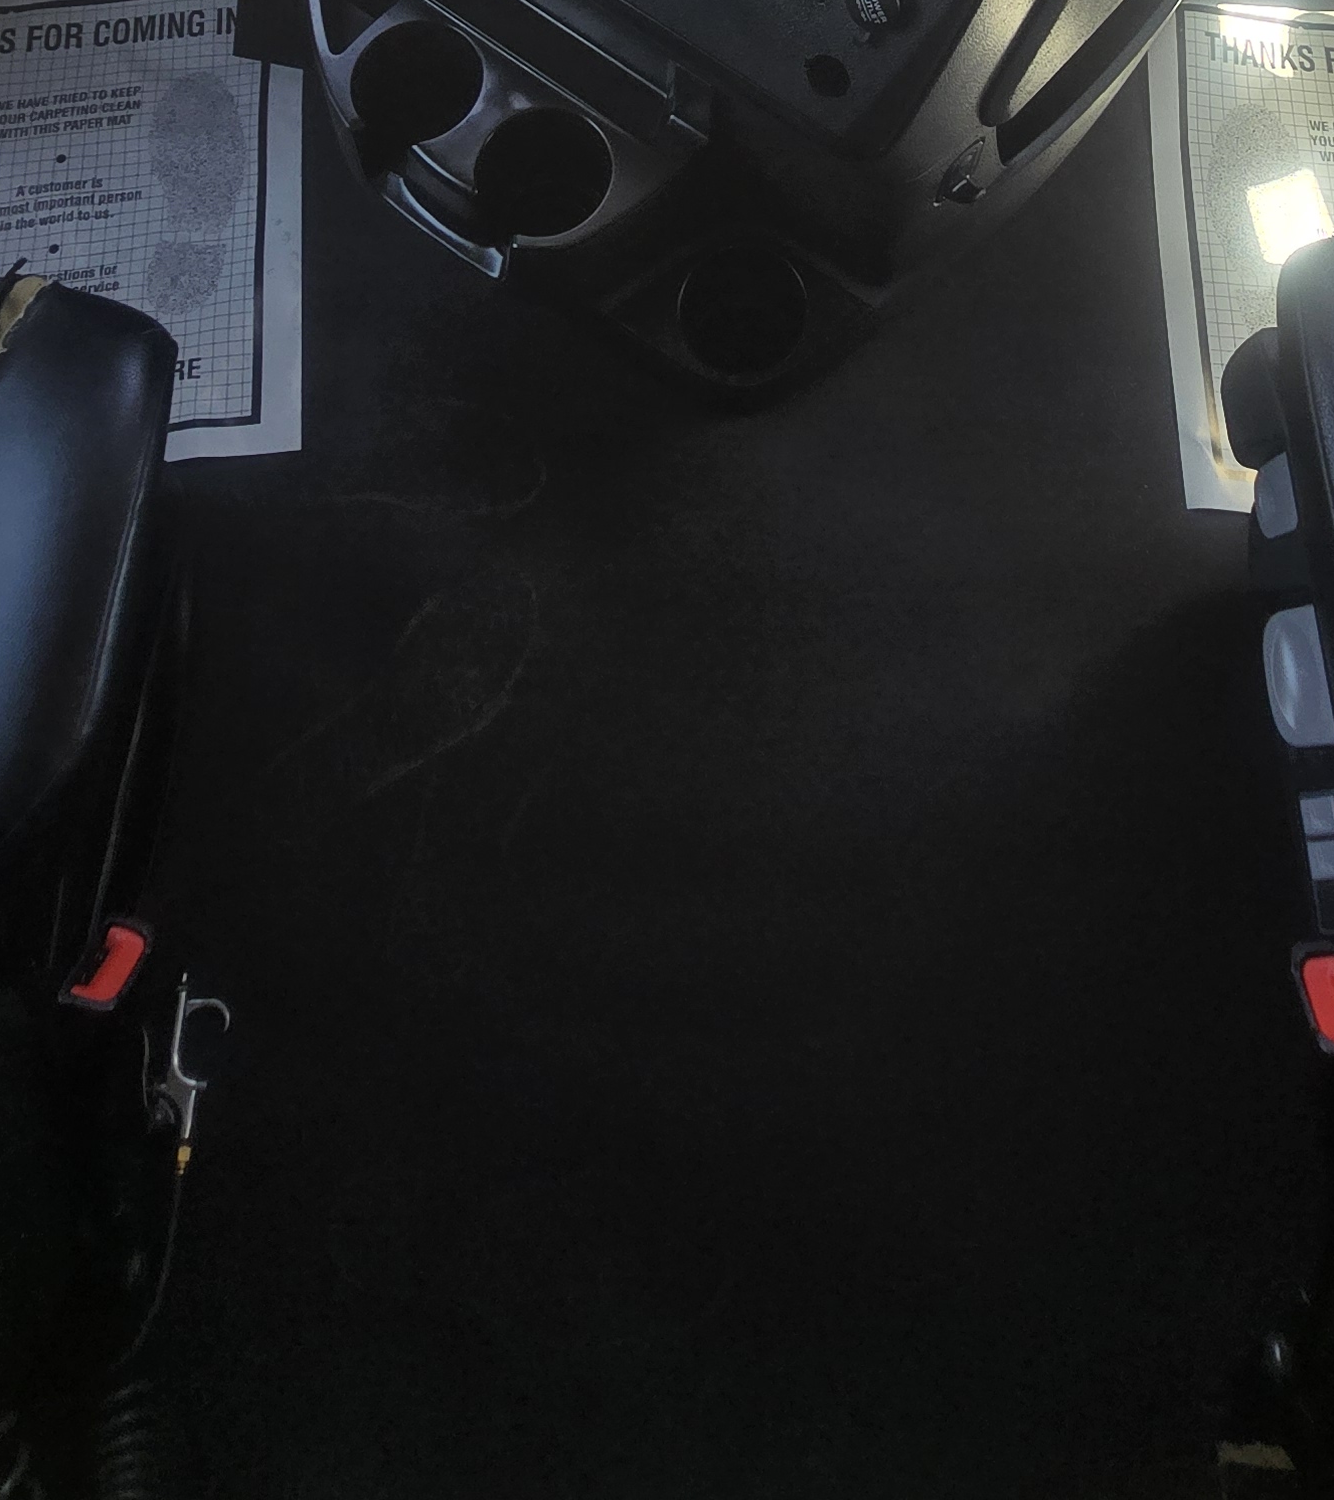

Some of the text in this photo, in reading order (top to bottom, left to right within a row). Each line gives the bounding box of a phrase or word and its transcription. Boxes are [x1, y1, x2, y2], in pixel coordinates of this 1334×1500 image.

[26, 23, 83, 52] FOR
[93, 8, 205, 47] COMING
[216, 7, 237, 35] IN
[1205, 31, 1315, 72] THANKS
[17, 96, 49, 109] HAVE
[53, 90, 87, 104] TRIED
[92, 89, 108, 100] TO
[110, 85, 142, 98] KEEP
[29, 104, 98, 122] CARPETING
[100, 99, 142, 113] CLEAN
[33, 122, 60, 136] THIS
[63, 117, 103, 132] PAPER
[107, 114, 134, 126] MAT
[1309, 120, 1329, 132] WE
[15, 175, 103, 197] A customer is
[0, 202, 30, 216] most
[33, 193, 95, 213] important
[98, 190, 143, 206] person
[15, 217, 36, 230] the
[39, 211, 74, 226] world
[77, 209, 90, 221] to
[100, 264, 118, 277] for
[174, 357, 202, 381] RE
